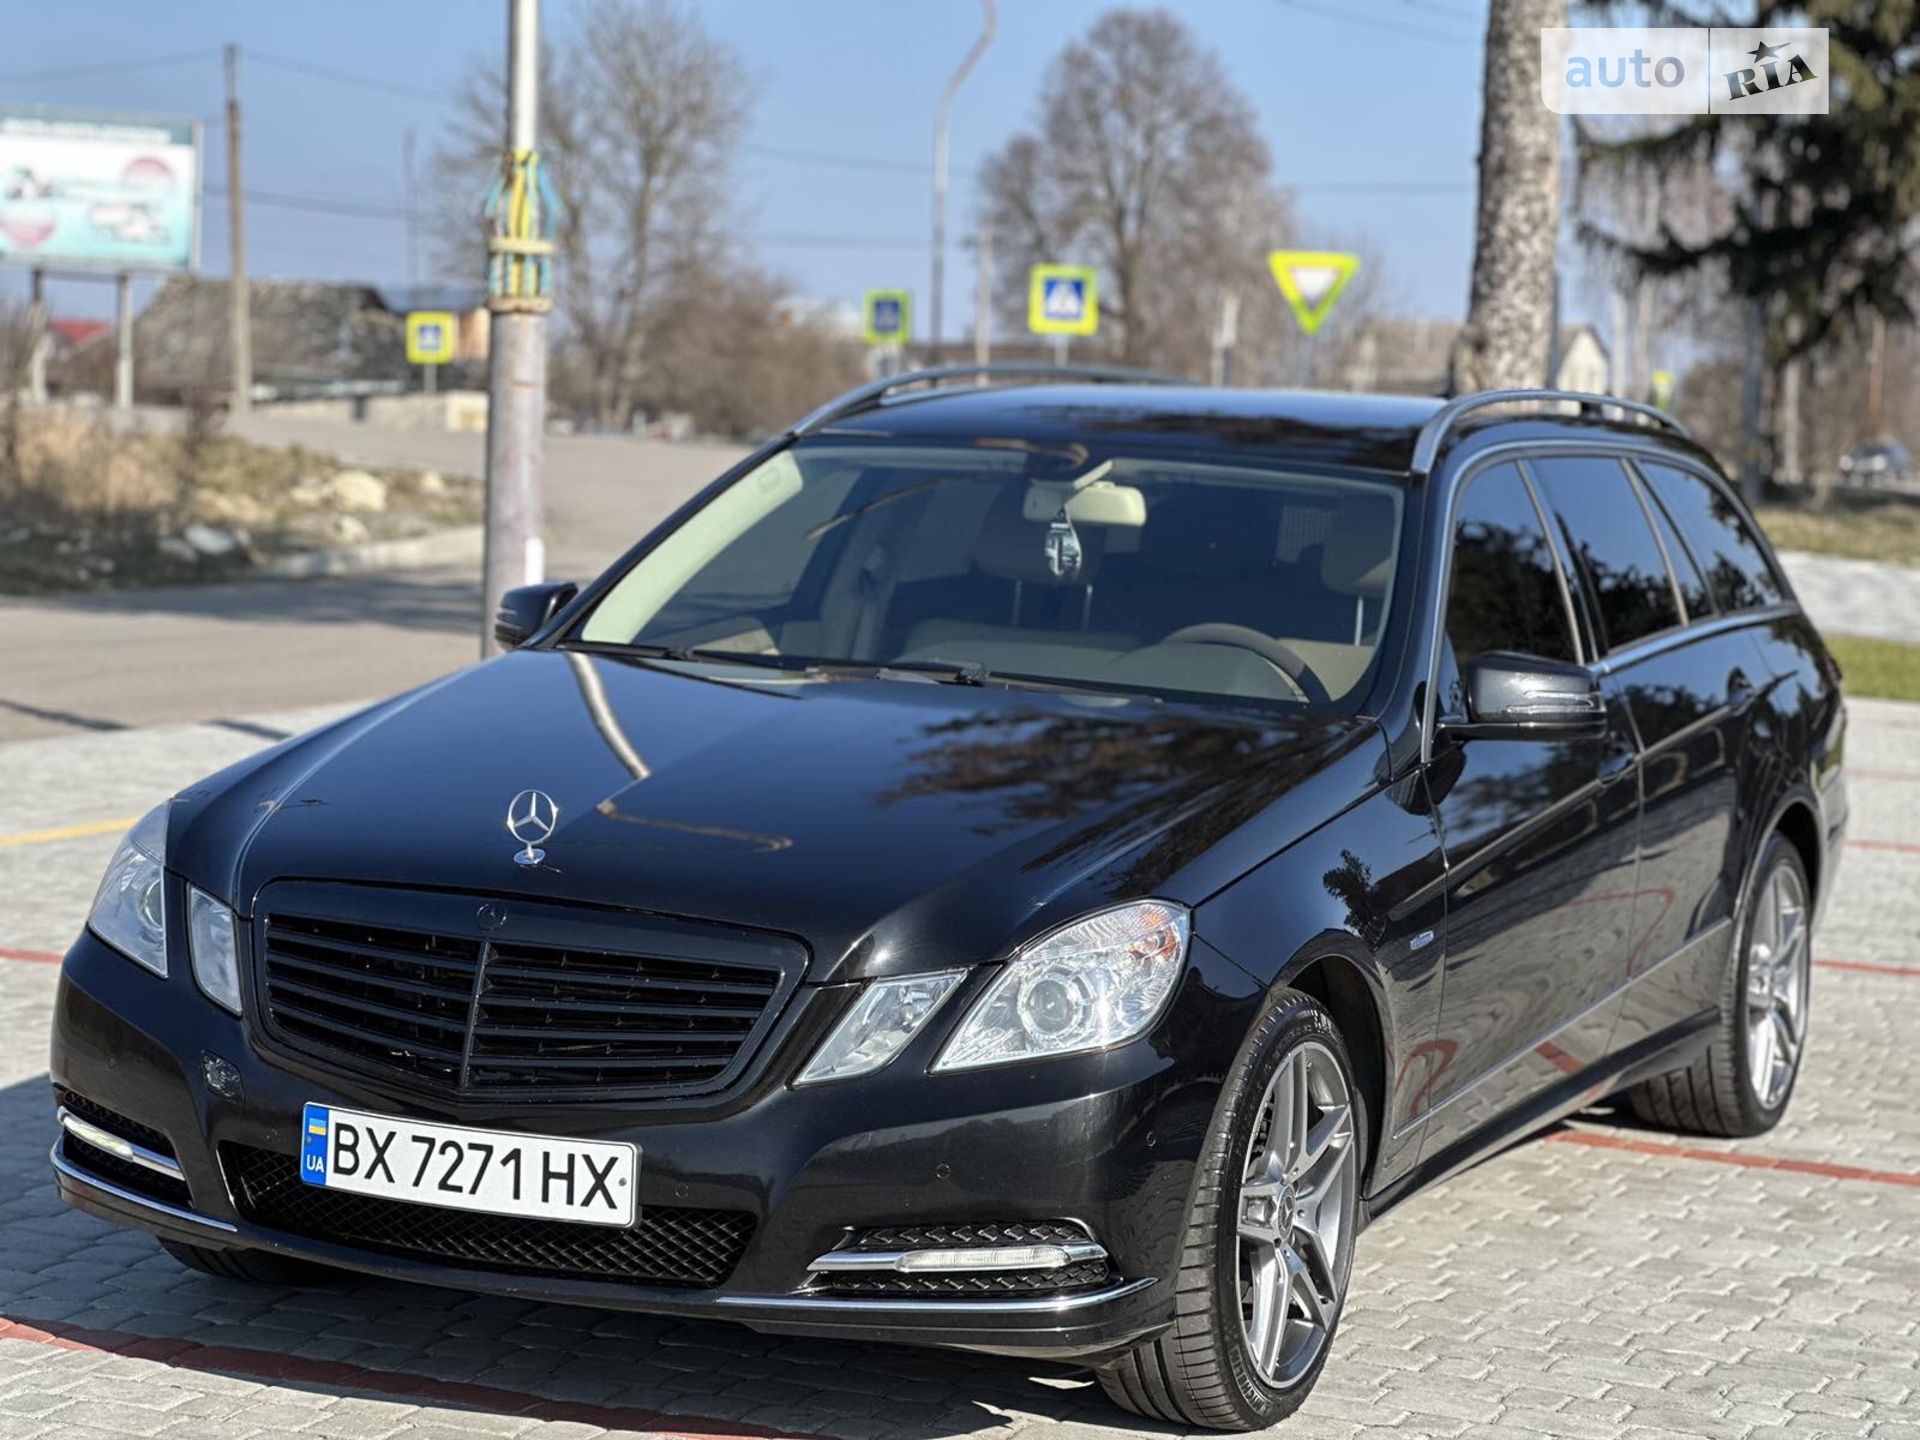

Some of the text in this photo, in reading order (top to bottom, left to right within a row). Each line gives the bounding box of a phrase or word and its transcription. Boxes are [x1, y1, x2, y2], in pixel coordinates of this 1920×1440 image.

[306, 1154, 325, 1173] UA
[333, 1122, 619, 1210] BX 7271 HX
[1229, 1346, 1266, 1414] MICHELIN
